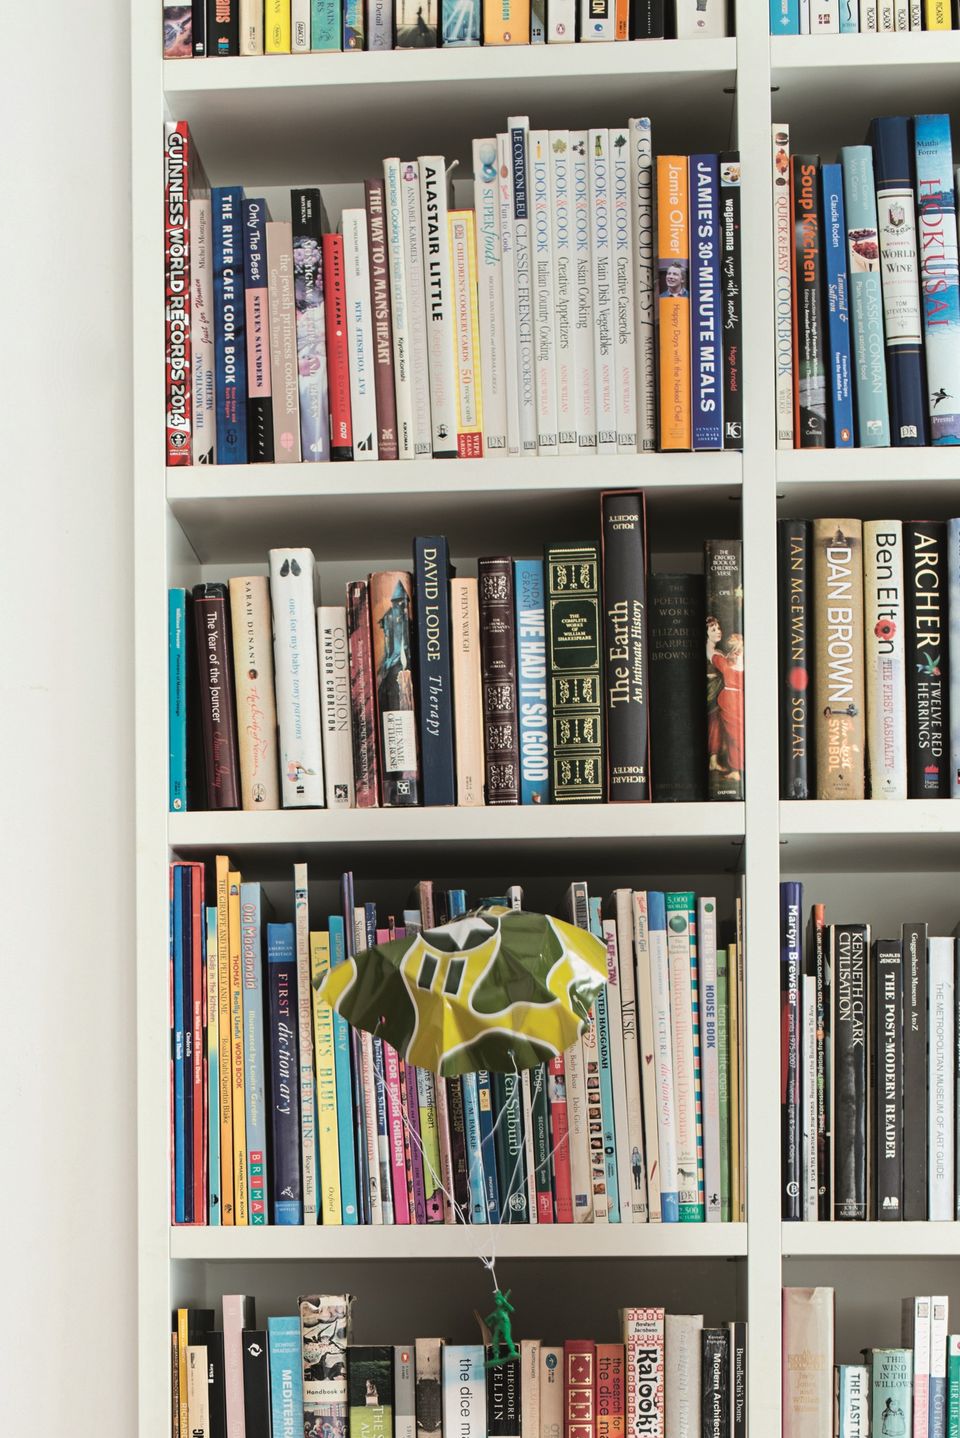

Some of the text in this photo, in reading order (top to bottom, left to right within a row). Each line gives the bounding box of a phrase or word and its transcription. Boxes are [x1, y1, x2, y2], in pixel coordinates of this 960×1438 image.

[248, 204, 262, 280] Only The Best
[425, 167, 443, 322] ALASTAIR LITTLE
[668, 163, 683, 253] Jamie Oliver
[798, 165, 818, 282] Soup Kitchen
[831, 195, 840, 247] Claudia Roden
[920, 179, 948, 326] HOKUSAI
[168, 132, 186, 426] GUINNESS WORLD RECORDS 2014
[222, 195, 236, 383] THE RIVER CAFE COOK BOOK
[369, 188, 389, 365] THE WAY TO A MAN'S HEART
[617, 257, 628, 296] Creative
[618, 299, 629, 344] Casseroles
[697, 162, 715, 412] JAMIE'S 30-MINUTE MEALS
[724, 199, 738, 391] wagamama Hugo Arnold
[790, 536, 803, 570] IAN
[915, 532, 940, 649] ARCHER
[207, 612, 221, 723] The Year of the Jouncer
[424, 548, 442, 736] DAVID LODGE Therapy
[608, 602, 630, 708] The Earth
[631, 600, 643, 704] An Intimate History
[826, 547, 853, 701] DAN BROWN
[519, 608, 548, 781] WE HAD IT SO GOOD
[792, 698, 805, 759] SOLAR
[918, 683, 929, 748] HERRINGS
[930, 681, 942, 757] TWELVE RED
[278, 973, 289, 1016] FIRST
[787, 905, 799, 1006] Martyn Brewster
[839, 932, 851, 1021] CIVILISATION
[851, 932, 864, 1046] KENNETH CLARK
[706, 985, 716, 1048] HOUSE BOOK
[885, 972, 896, 1159] THE POST-MODERN READER
[460, 1359, 472, 1382] the
[460, 1387, 473, 1416] dice
[713, 1353, 721, 1389] Modern
[736, 1348, 744, 1397] Brunelleschi's
[850, 1374, 860, 1395] THE
[850, 1398, 860, 1426] LAST
